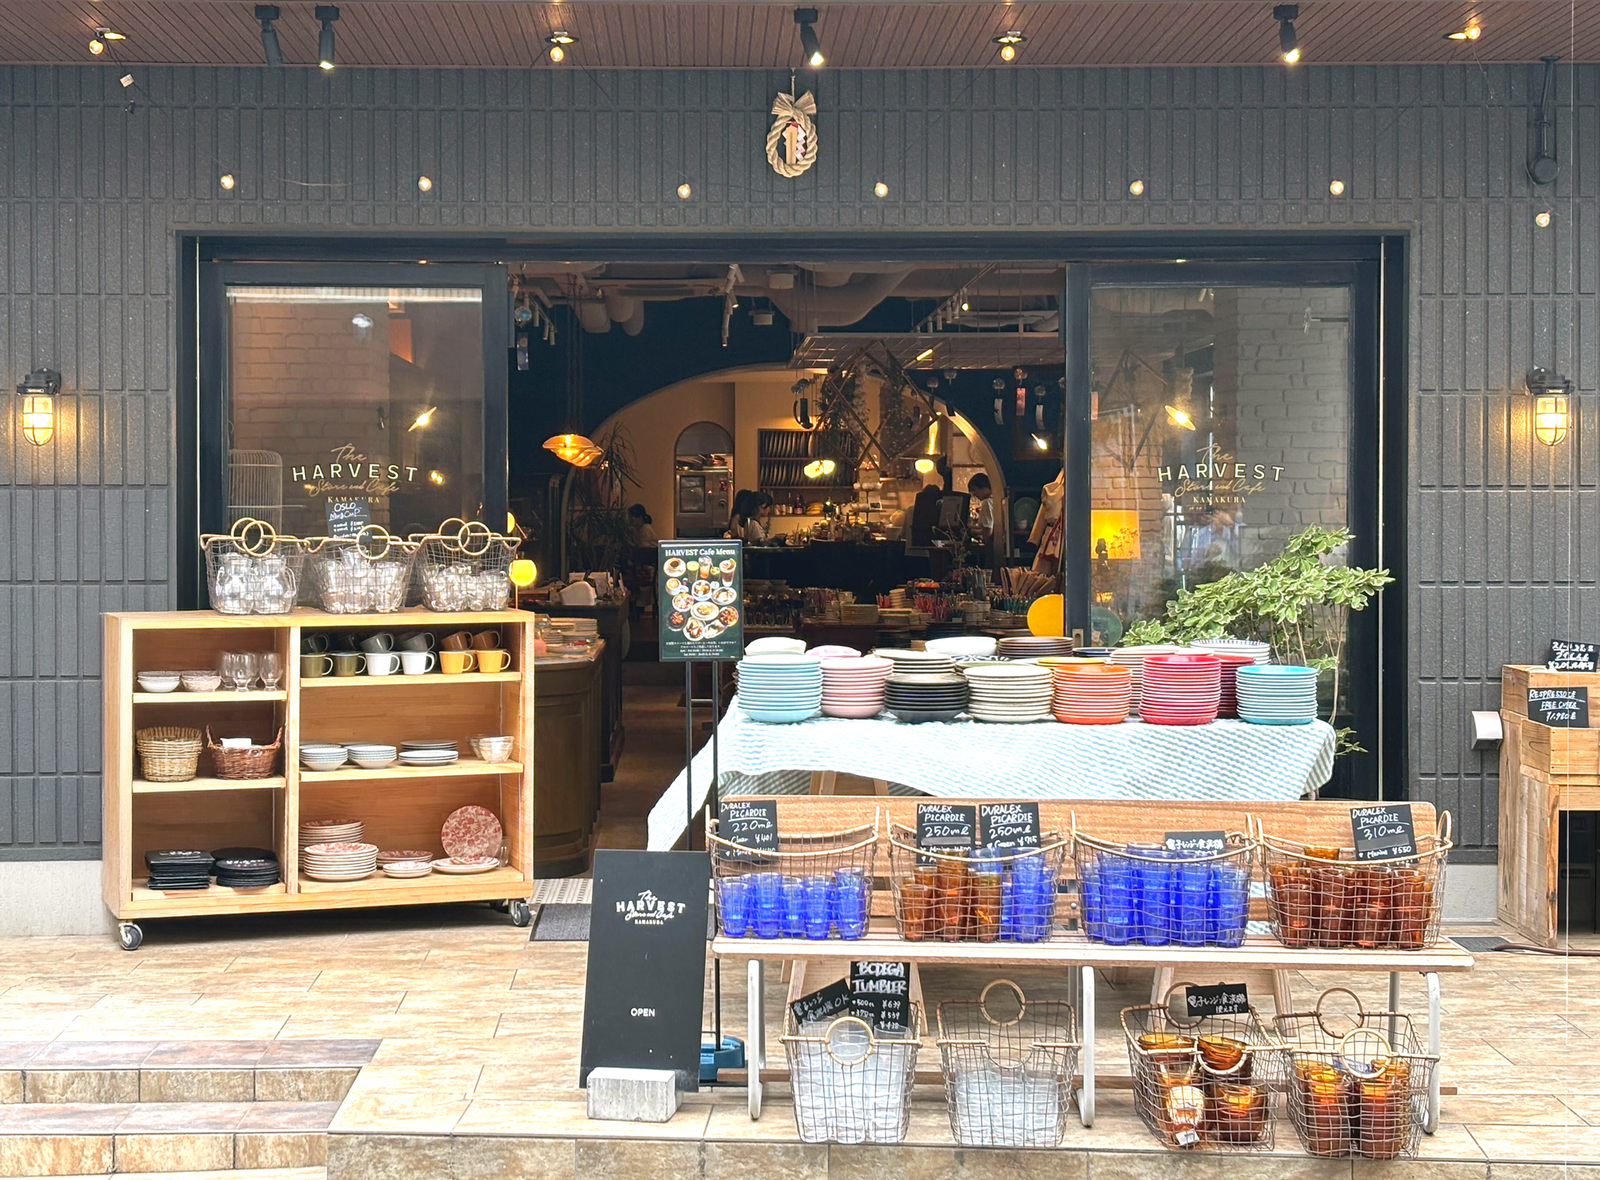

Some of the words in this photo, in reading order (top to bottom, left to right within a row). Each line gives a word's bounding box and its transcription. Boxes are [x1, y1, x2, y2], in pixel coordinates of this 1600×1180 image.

[331, 443, 367, 463] The
[1196, 442, 1233, 464] The
[292, 463, 418, 481] HARVEST
[1157, 463, 1285, 482] HARVEST
[309, 479, 348, 497] Store
[1193, 496, 1246, 504] KAMAKURA
[334, 502, 356, 512] OSLO
[665, 549, 699, 557] HARVEST
[699, 548, 715, 556] Cafe
[715, 548, 736, 556] Menu
[730, 808, 767, 820] PICARDIE
[918, 805, 953, 814] DURALEX
[981, 804, 1022, 817] DURALEX
[1352, 807, 1387, 819] DURALEX
[924, 813, 965, 822] PICARDIE
[990, 812, 1033, 825] PICARDIE
[1360, 813, 1399, 828] PICARDIE
[616, 900, 686, 914] HARVEST
[856, 961, 905, 978] BODEGA
[852, 979, 908, 996] TUMBLER
[630, 1007, 656, 1017] OPEN
